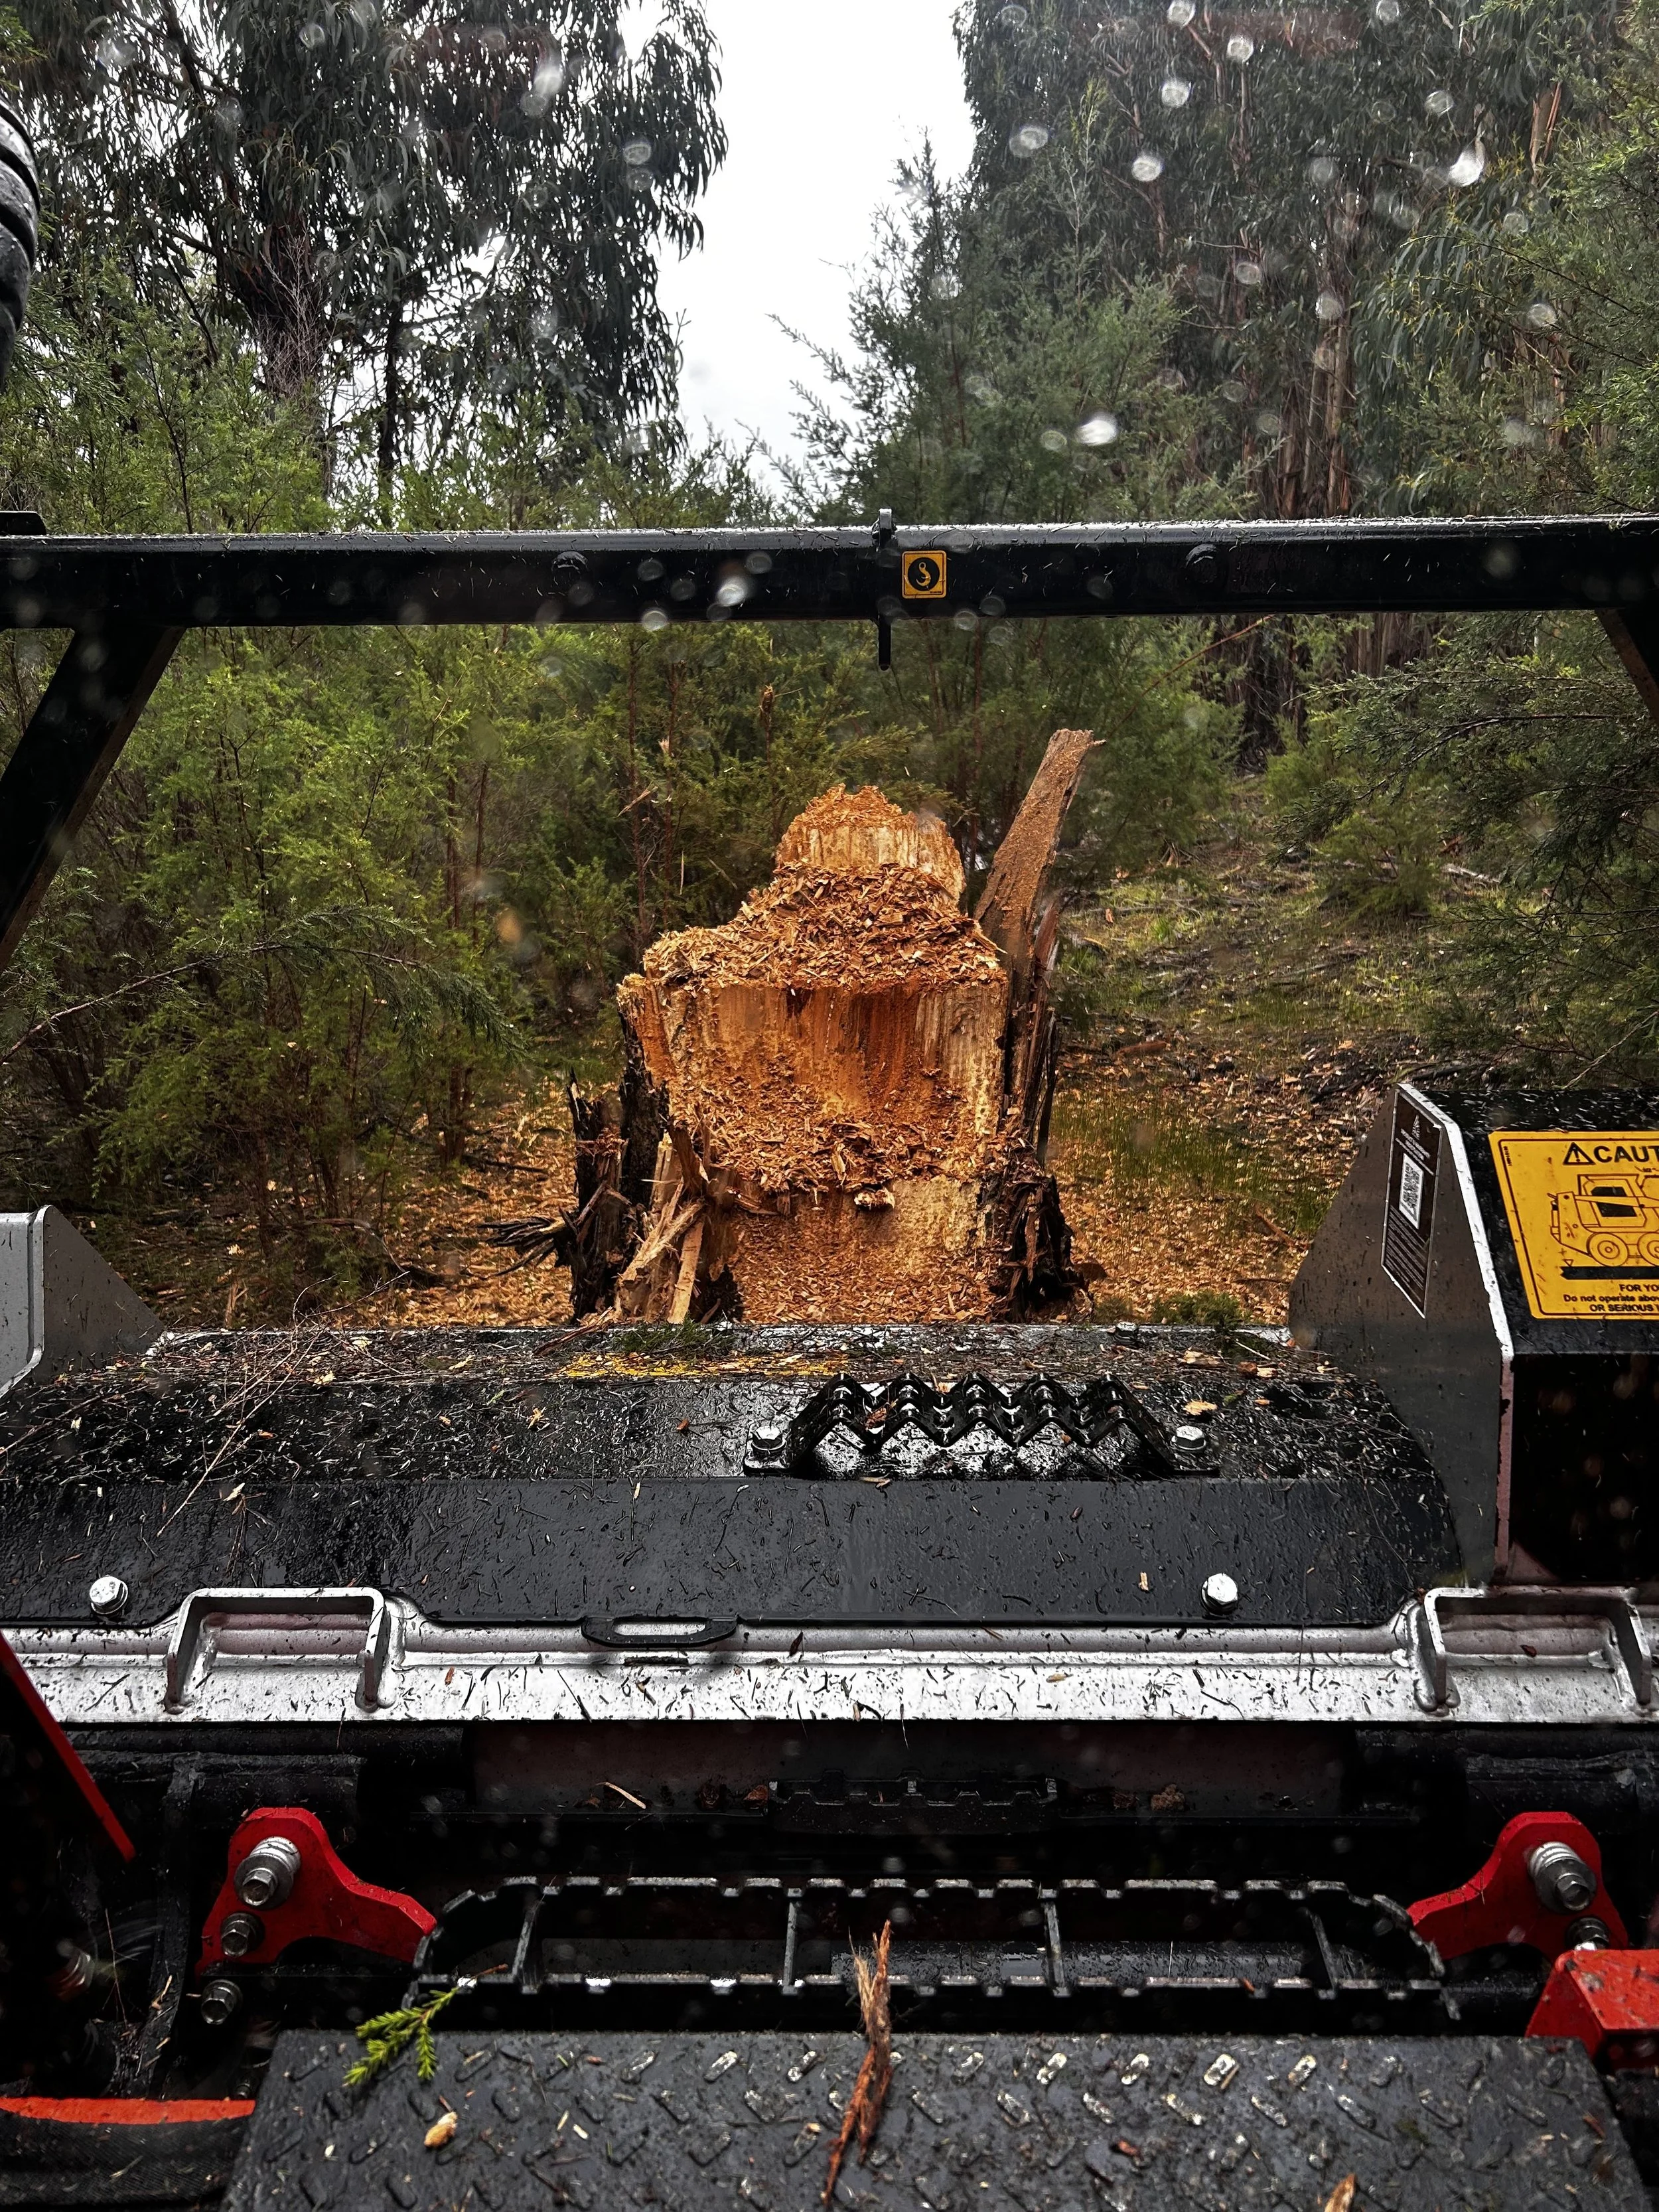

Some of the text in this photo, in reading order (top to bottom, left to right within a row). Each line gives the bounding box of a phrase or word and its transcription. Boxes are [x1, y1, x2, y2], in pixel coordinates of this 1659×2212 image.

[1619, 1284, 1642, 1292] FOR
[1598, 1295, 1636, 1303] operate
[1607, 1303, 1654, 1312] SERIOUS
